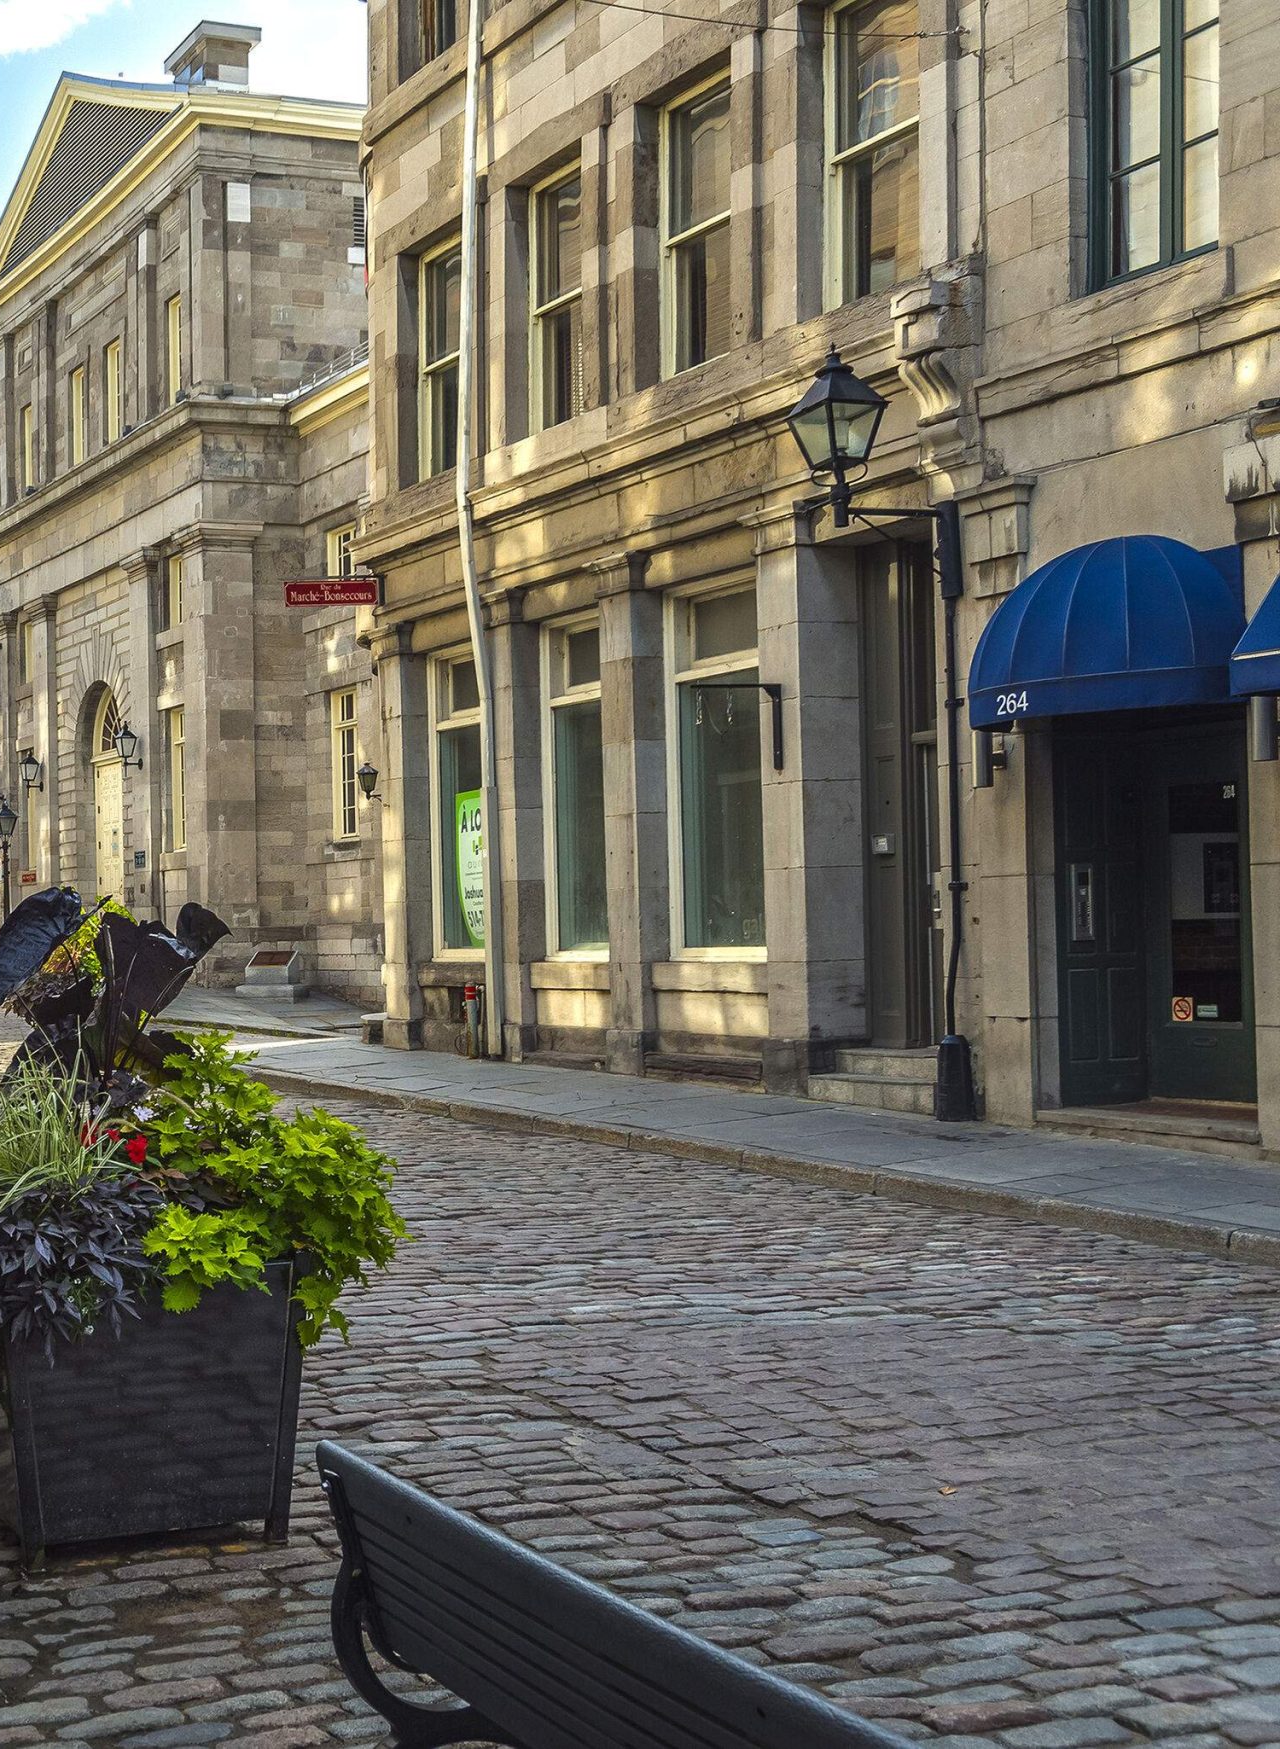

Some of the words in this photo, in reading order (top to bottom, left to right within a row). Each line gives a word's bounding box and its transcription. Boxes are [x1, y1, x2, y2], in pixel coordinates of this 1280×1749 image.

[290, 590, 373, 602] Marché-Bonsecours
[996, 690, 1029, 716] 264
[1222, 784, 1236, 799] 264
[461, 804, 468, 833] À
[470, 807, 482, 832] LO
